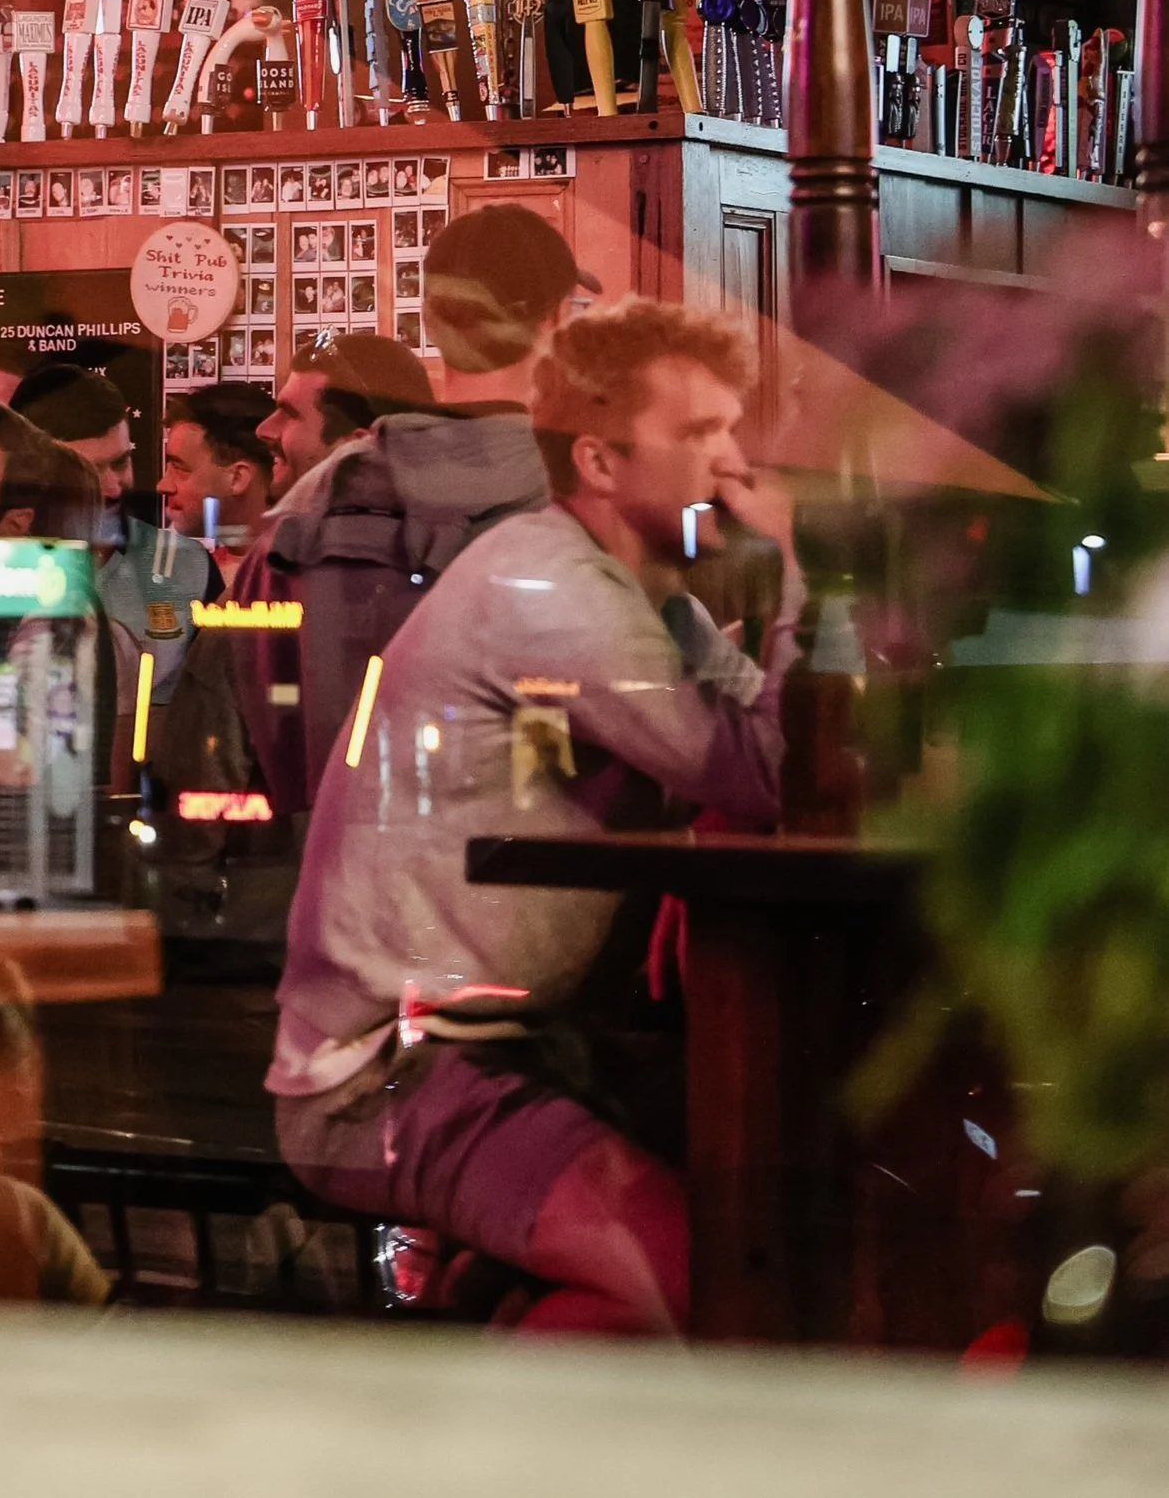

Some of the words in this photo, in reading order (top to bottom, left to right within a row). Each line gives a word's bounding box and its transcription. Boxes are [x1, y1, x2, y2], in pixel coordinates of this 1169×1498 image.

[185, 6, 212, 27] IPA
[881, 4, 904, 21] IPA
[910, 8, 926, 25] IPA
[970, 54, 983, 151] STOCKADE
[982, 85, 996, 146] LAGER
[146, 249, 182, 264] Shit
[195, 254, 228, 268] Pub
[158, 265, 215, 282] Trivia
[144, 282, 216, 297] winners
[0, 327, 15, 338] 25
[17, 325, 74, 338] DUNCAN
[78, 322, 141, 336] PHILLIPS
[27, 341, 36, 352] &
[39, 339, 77, 351] BAND
